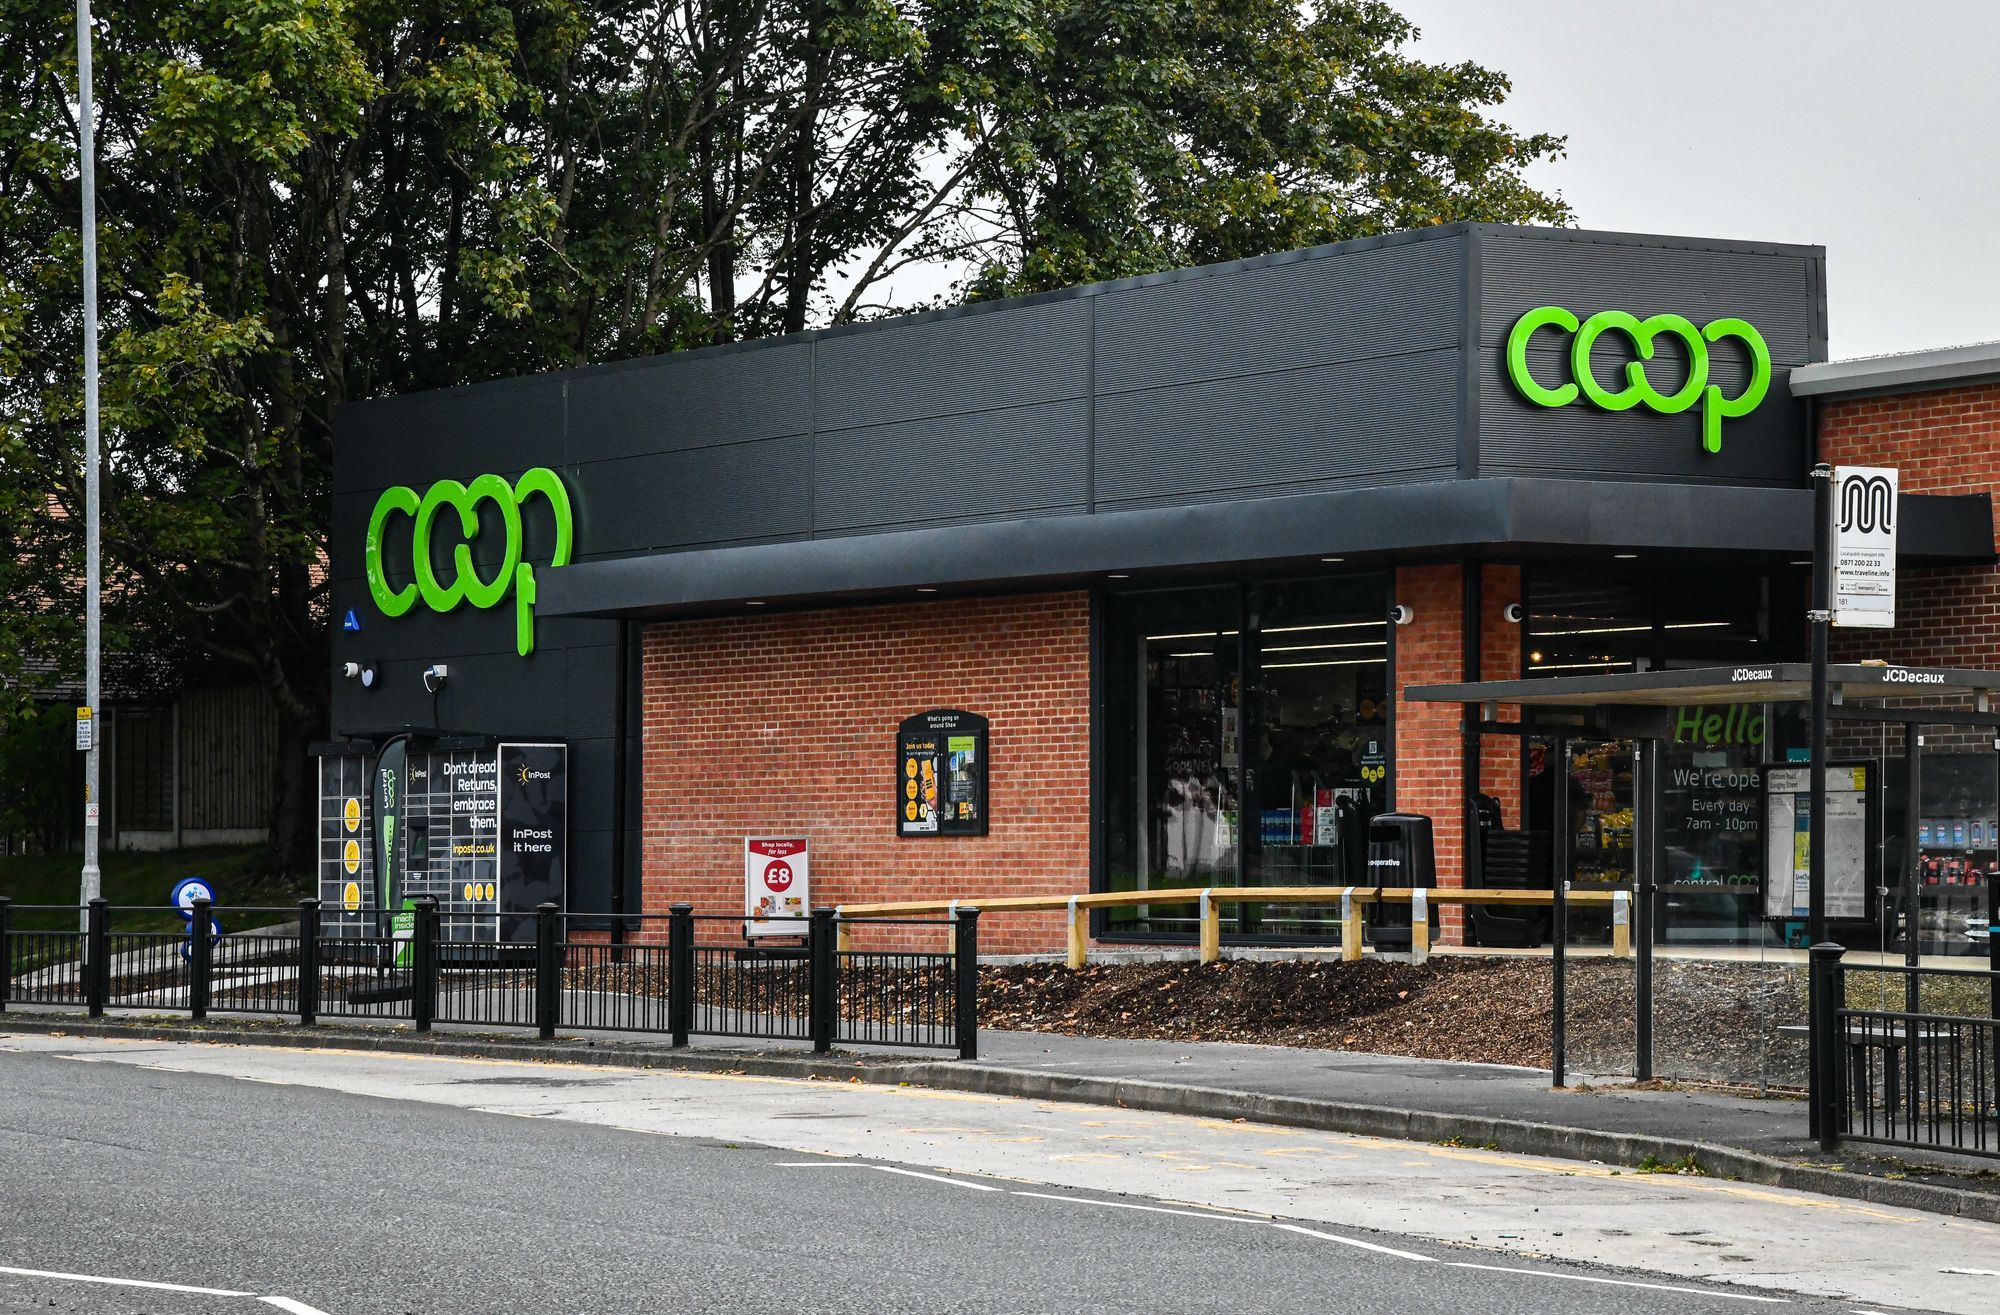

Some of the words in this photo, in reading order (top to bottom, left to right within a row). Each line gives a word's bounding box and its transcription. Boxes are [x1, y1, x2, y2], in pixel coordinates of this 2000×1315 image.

[1507, 306, 1772, 453] coop
[1732, 668, 1773, 682] JCDecaux
[1882, 669, 1945, 683] JCDecaux
[906, 742, 916, 750] Join
[923, 742, 935, 750] today
[444, 762, 468, 775] Don't
[469, 760, 496, 774] dread
[528, 771, 551, 779] InPost
[1673, 768, 1723, 786] We're
[1728, 773, 1760, 791] ope
[381, 769, 389, 808] central
[458, 778, 497, 792] Returns,
[454, 798, 495, 811] embrace
[1692, 799, 1725, 814] Every
[1729, 799, 1750, 813] day
[470, 816, 497, 829] them.
[1685, 817, 1711, 830] 7am
[1725, 818, 1758, 832] 10pm
[513, 829, 552, 838] InPost
[453, 843, 495, 856] inpost.co.uk
[514, 842, 522, 852] it
[524, 843, 552, 852] here
[768, 868, 790, 884] £8
